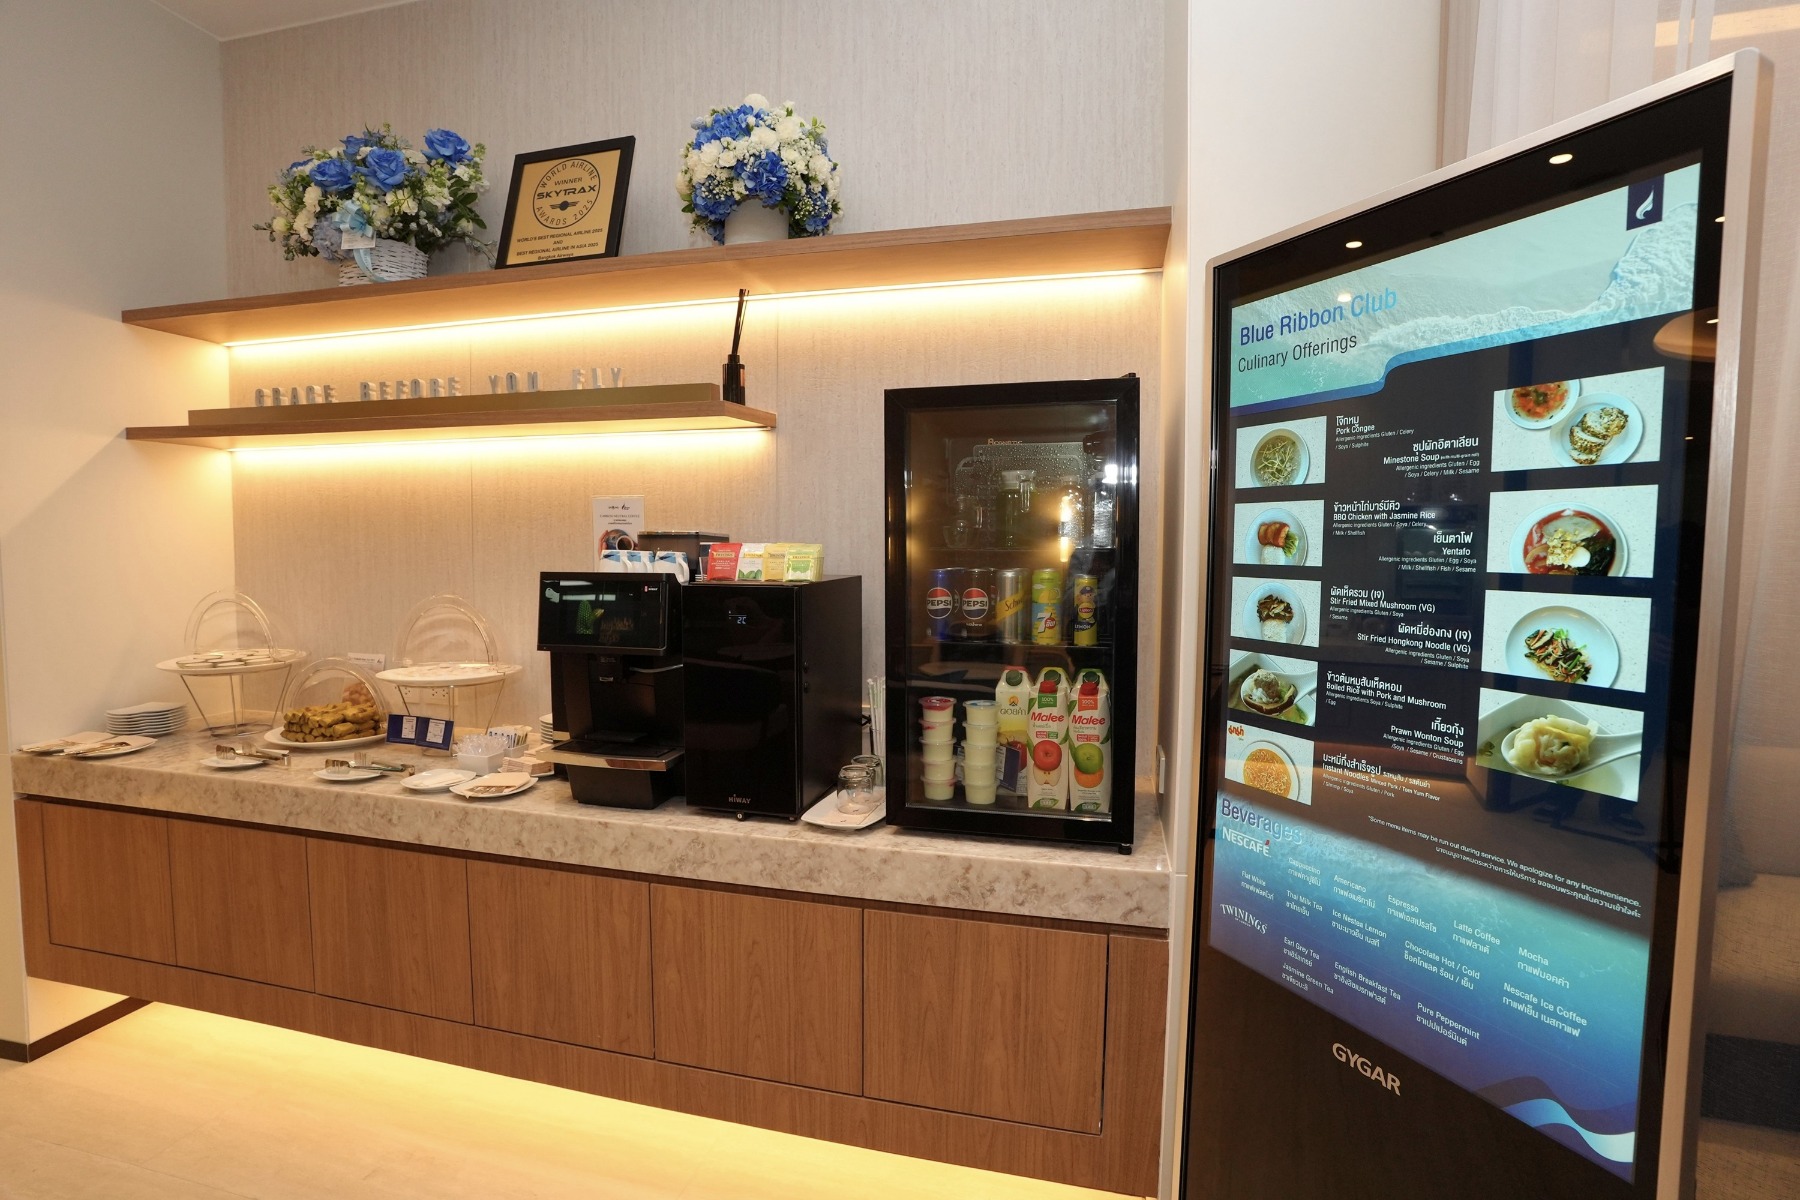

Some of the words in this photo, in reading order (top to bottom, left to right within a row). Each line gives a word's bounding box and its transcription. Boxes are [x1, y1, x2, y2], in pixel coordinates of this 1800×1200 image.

[540, 164, 567, 188] WORLD
[570, 161, 597, 181] AIRLINE
[555, 177, 582, 186] WINNER
[537, 185, 597, 199] SKYTRAX
[536, 207, 567, 224] AWARDS
[573, 200, 593, 220] 2025
[1240, 324, 1274, 346] Blue
[1280, 305, 1344, 335] Ribbon
[1350, 288, 1398, 317] Club
[1238, 351, 1288, 372] Culinary
[1292, 335, 1357, 360] Offerings
[360, 377, 462, 401] BEFORE
[488, 371, 539, 394] YOU
[572, 367, 623, 389] FLY
[1336, 427, 1350, 435] Pork
[1351, 424, 1375, 433] Congee
[1413, 436, 1479, 455] ซุปผักอิตาเลียน
[1384, 455, 1419, 464] Minestone
[1421, 453, 1440, 461] Soup
[1433, 531, 1473, 544] เย็นตาโฟ
[1442, 547, 1470, 555] Yentafo
[1342, 598, 1357, 606] Fried
[1380, 600, 1417, 610] Mushroom
[1419, 603, 1436, 613] (VG)
[1371, 589, 1385, 600] (เจ)
[1370, 634, 1387, 643] Fried
[1388, 637, 1423, 649] Hongkong
[1425, 641, 1451, 651] Noodle
[1453, 644, 1471, 655] (VG)
[1455, 629, 1472, 642] (เจ)
[1326, 682, 1345, 692] Boiled
[1346, 685, 1360, 694] Rice
[1361, 688, 1375, 697] with
[1376, 692, 1391, 700] Pork
[1408, 696, 1447, 709] Mushroom
[1031, 712, 1064, 722] Malee
[1072, 715, 1106, 725] Malee
[1390, 725, 1412, 736] Prawn
[1414, 730, 1442, 743] Wonton
[1444, 736, 1464, 748] Soup
[1323, 763, 1342, 774] Instant
[1344, 769, 1369, 782] Noodles
[1222, 798, 1302, 845] Beverages
[1222, 826, 1271, 858] NESCAFÉ
[1289, 857, 1320, 875] Cappuccino
[1386, 822, 1401, 831] menu
[1402, 825, 1416, 836] items
[1418, 831, 1429, 841] may
[1460, 845, 1480, 857] during
[1481, 852, 1506, 864] service.
[1507, 858, 1518, 868] We
[1519, 864, 1553, 880] apologize
[1555, 874, 1564, 883] for
[1566, 878, 1580, 889] any
[1581, 882, 1641, 908] inconvenience.
[1242, 870, 1251, 880] Flat
[1252, 874, 1266, 886] White
[1334, 875, 1366, 893] Americano
[1287, 890, 1298, 901] Thai
[1299, 895, 1312, 907] Milk
[1313, 901, 1323, 912] Tea
[1388, 894, 1419, 913] Espresso
[1220, 903, 1268, 935] TWININGS
[1332, 909, 1341, 919] Ice
[1342, 914, 1363, 928] Nestea
[1364, 923, 1387, 939] Lemon
[1453, 920, 1473, 934] Latte
[1474, 929, 1500, 945] Coffee
[1284, 937, 1295, 948] Earl
[1296, 942, 1308, 955] Grey
[1310, 949, 1320, 960] Tea
[1405, 940, 1440, 962] Chocolate
[1441, 956, 1455, 969] Hot
[1462, 965, 1480, 980] Cold
[1518, 947, 1549, 966] Mocha
[1282, 963, 1305, 979] Jasmine
[1306, 973, 1323, 988] Green
[1324, 984, 1334, 994] Tea
[1335, 961, 1357, 978] English
[1358, 973, 1388, 993] Breakfast
[1390, 989, 1401, 1000] Tea
[1503, 982, 1538, 1004] Nescafe
[1541, 999, 1554, 1011] Ice
[1557, 1006, 1588, 1026] Coffee
[1503, 996, 1538, 1019] กาแฟเย็น
[1417, 1002, 1434, 1016] Pure
[1436, 1011, 1480, 1040] Peppermint
[1332, 1043, 1400, 1096] GYGAR
